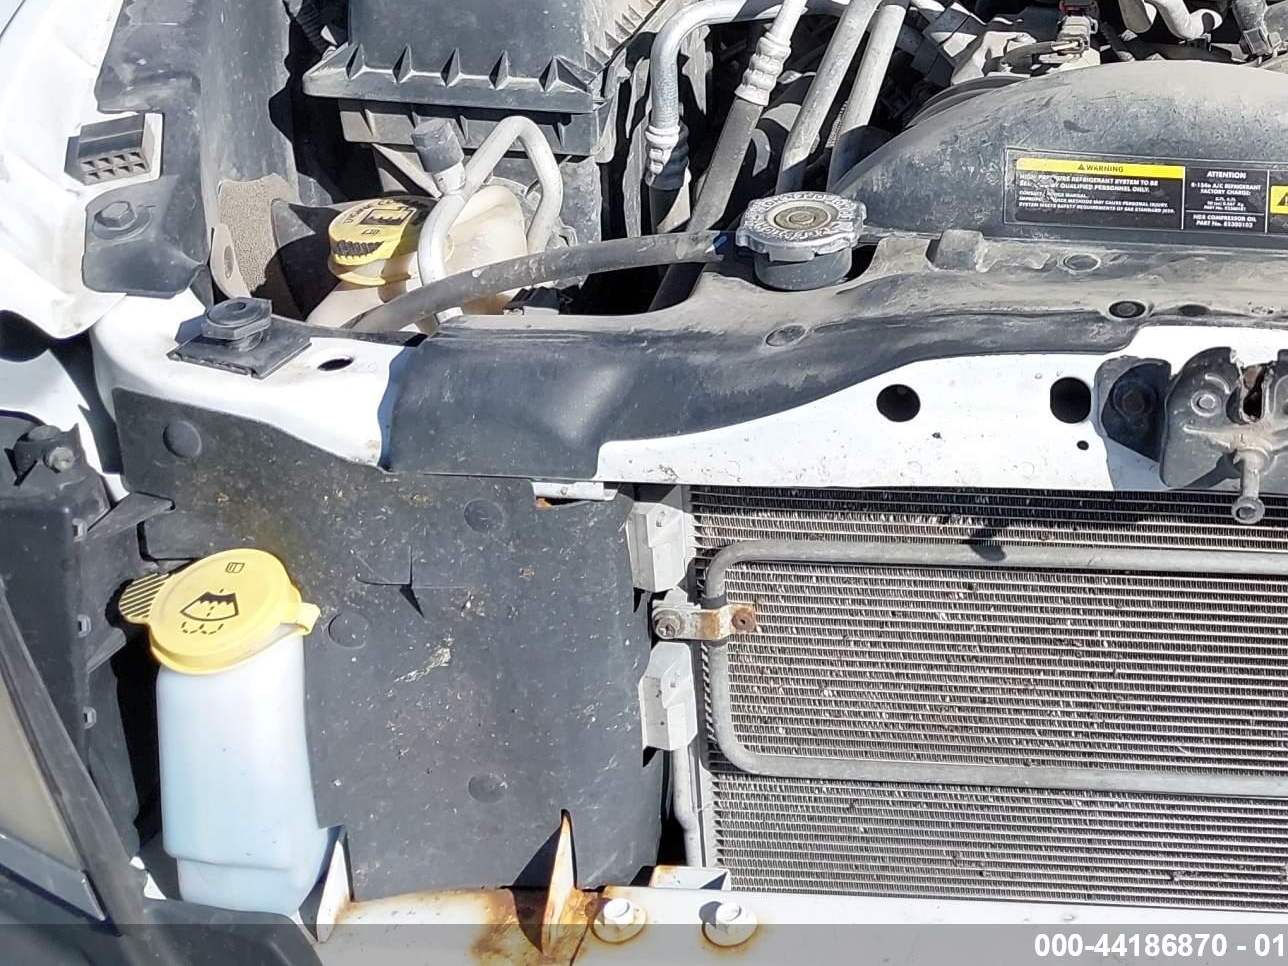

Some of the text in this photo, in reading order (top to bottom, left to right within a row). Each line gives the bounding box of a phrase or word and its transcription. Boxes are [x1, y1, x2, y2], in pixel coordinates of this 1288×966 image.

[1086, 165, 1124, 173] WARNING
[1071, 176, 1114, 185] REFRIGERANT
[1115, 178, 1139, 186] SYSTEM
[1060, 183, 1093, 191] QUALIFIED
[1094, 184, 1131, 192] PERSONNEL
